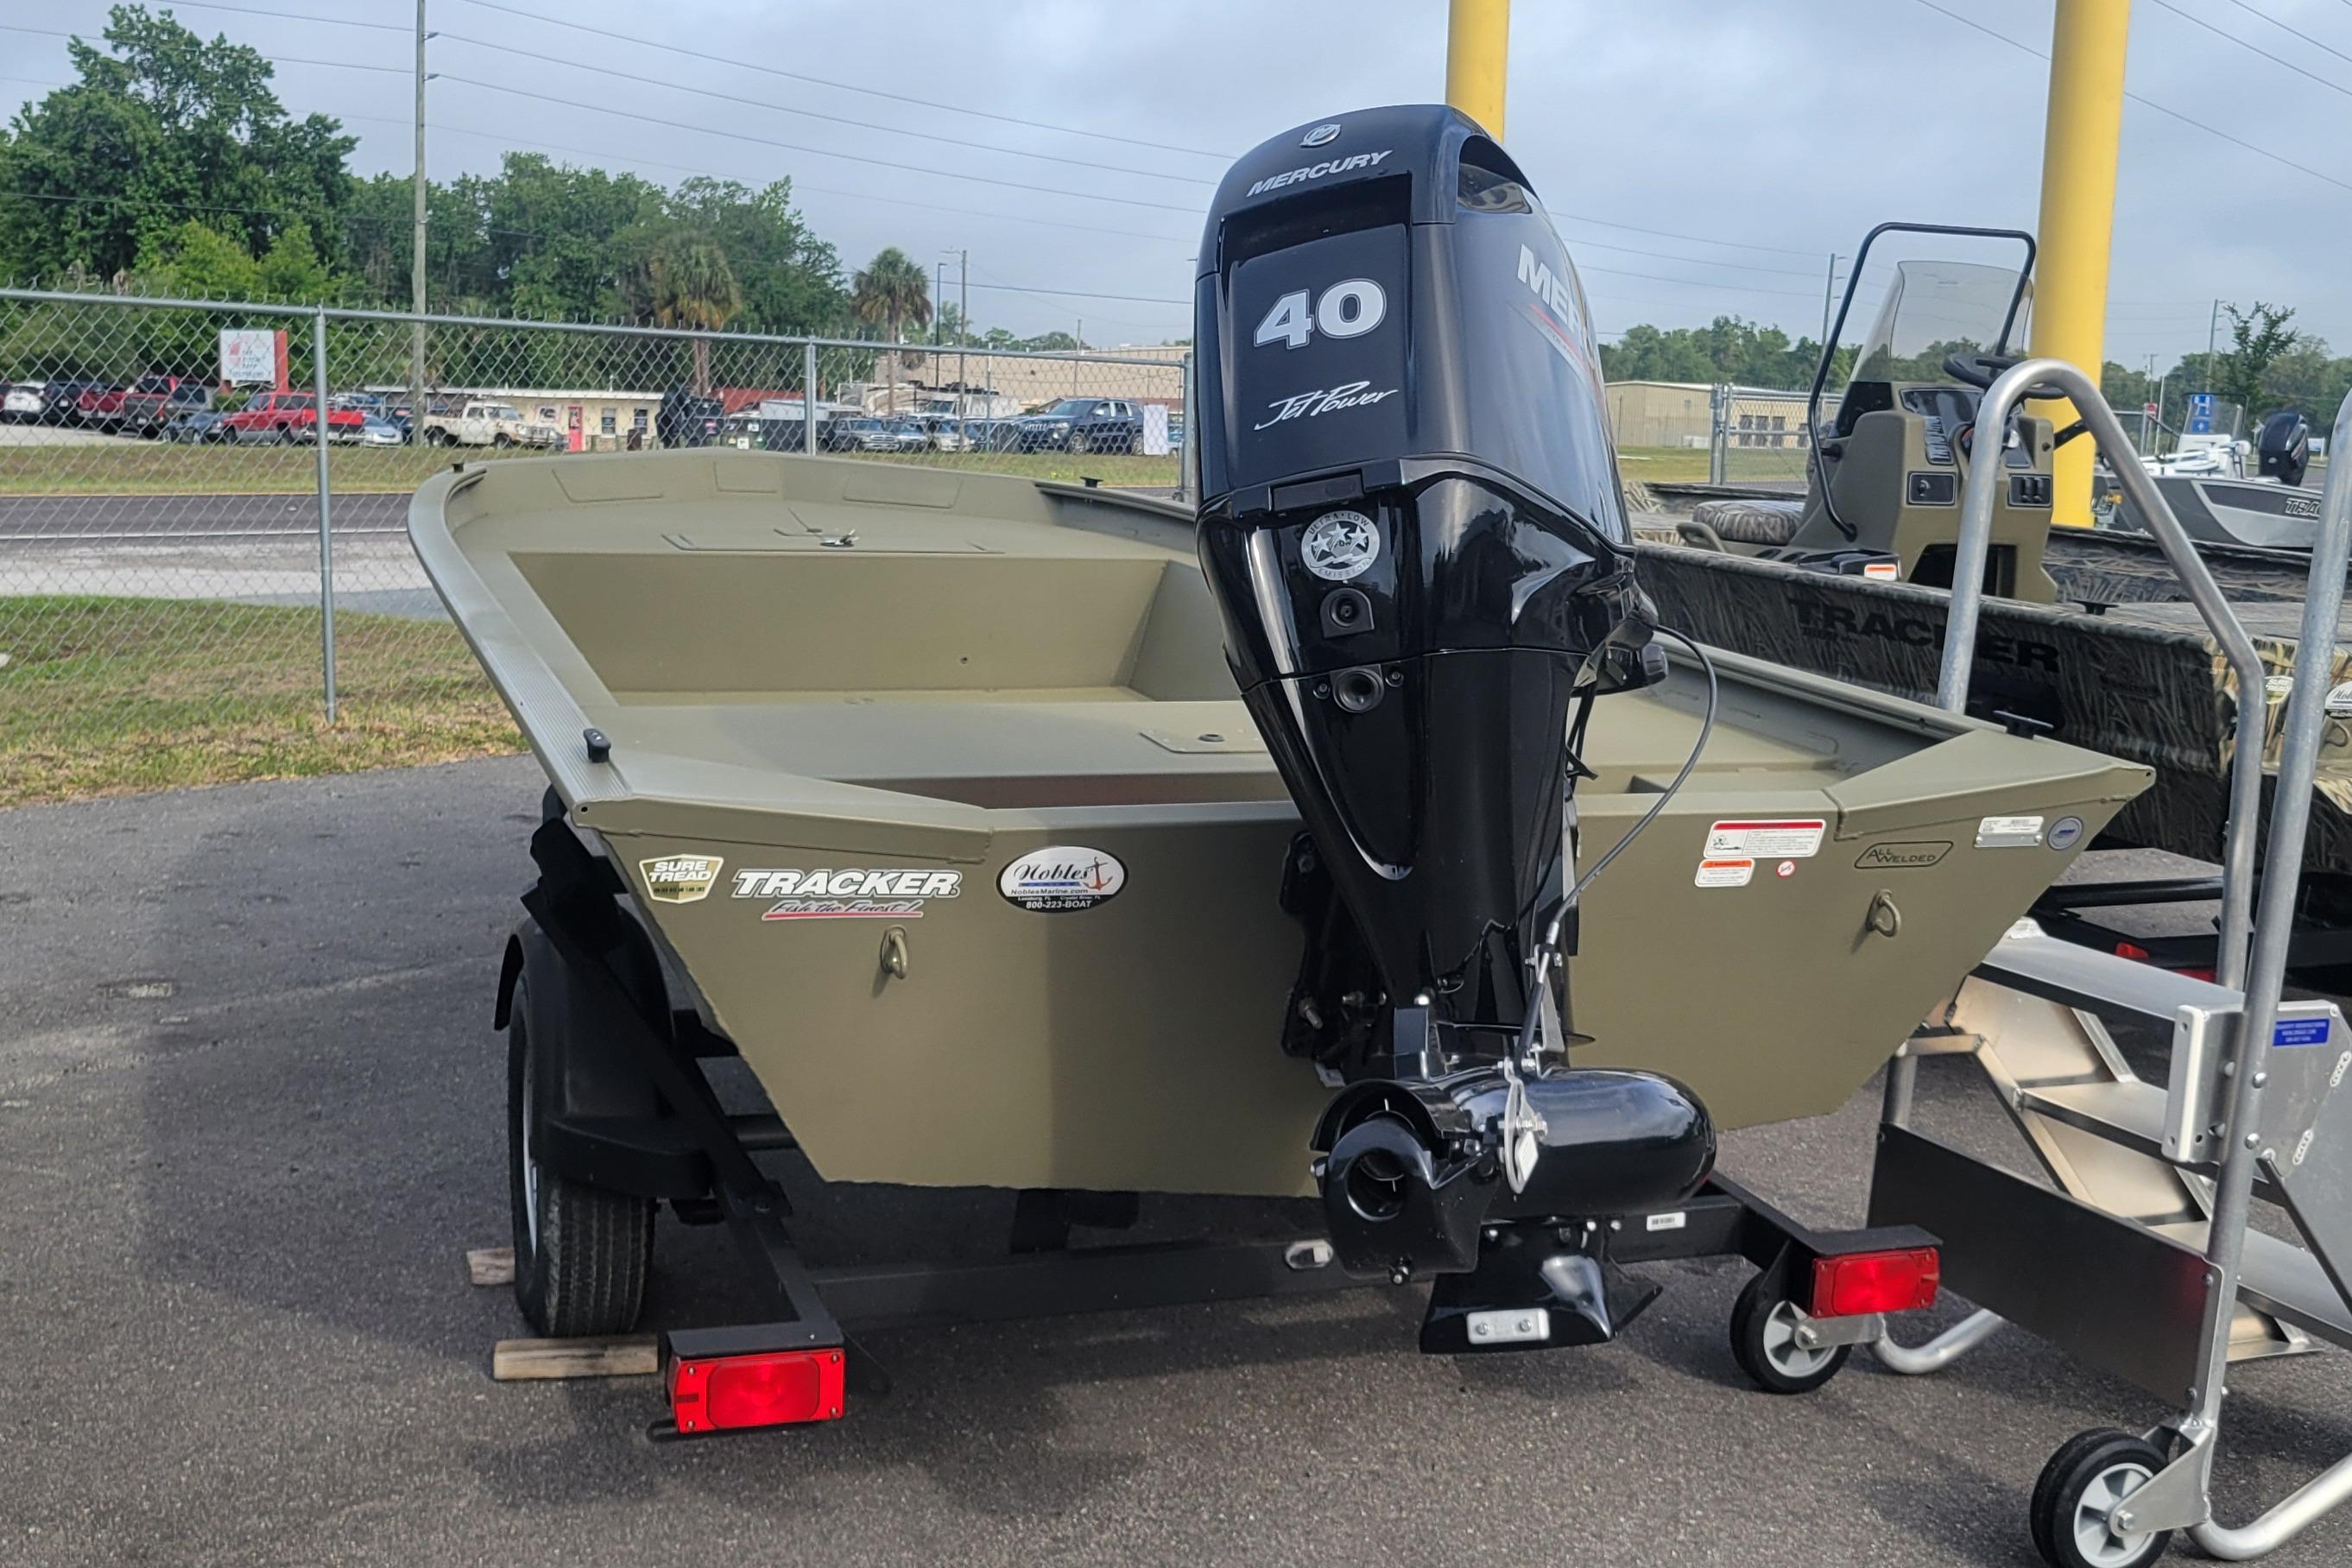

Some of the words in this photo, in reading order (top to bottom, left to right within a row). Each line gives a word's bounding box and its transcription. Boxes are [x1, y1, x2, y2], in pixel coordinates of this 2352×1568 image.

[1246, 149, 1394, 198] MERCURY
[1254, 279, 1386, 349] 40
[1254, 390, 1331, 430] Jet
[1309, 381, 1399, 416] Power
[1347, 513, 1370, 528] LOW
[1790, 597, 2060, 673] TRACER
[648, 870, 712, 882] TREAD
[654, 861, 708, 872] SURE
[735, 870, 952, 896] TRACKER
[771, 901, 812, 913] Fish
[813, 902, 841, 913] the
[1025, 901, 1093, 910] 800-223-BOAT
